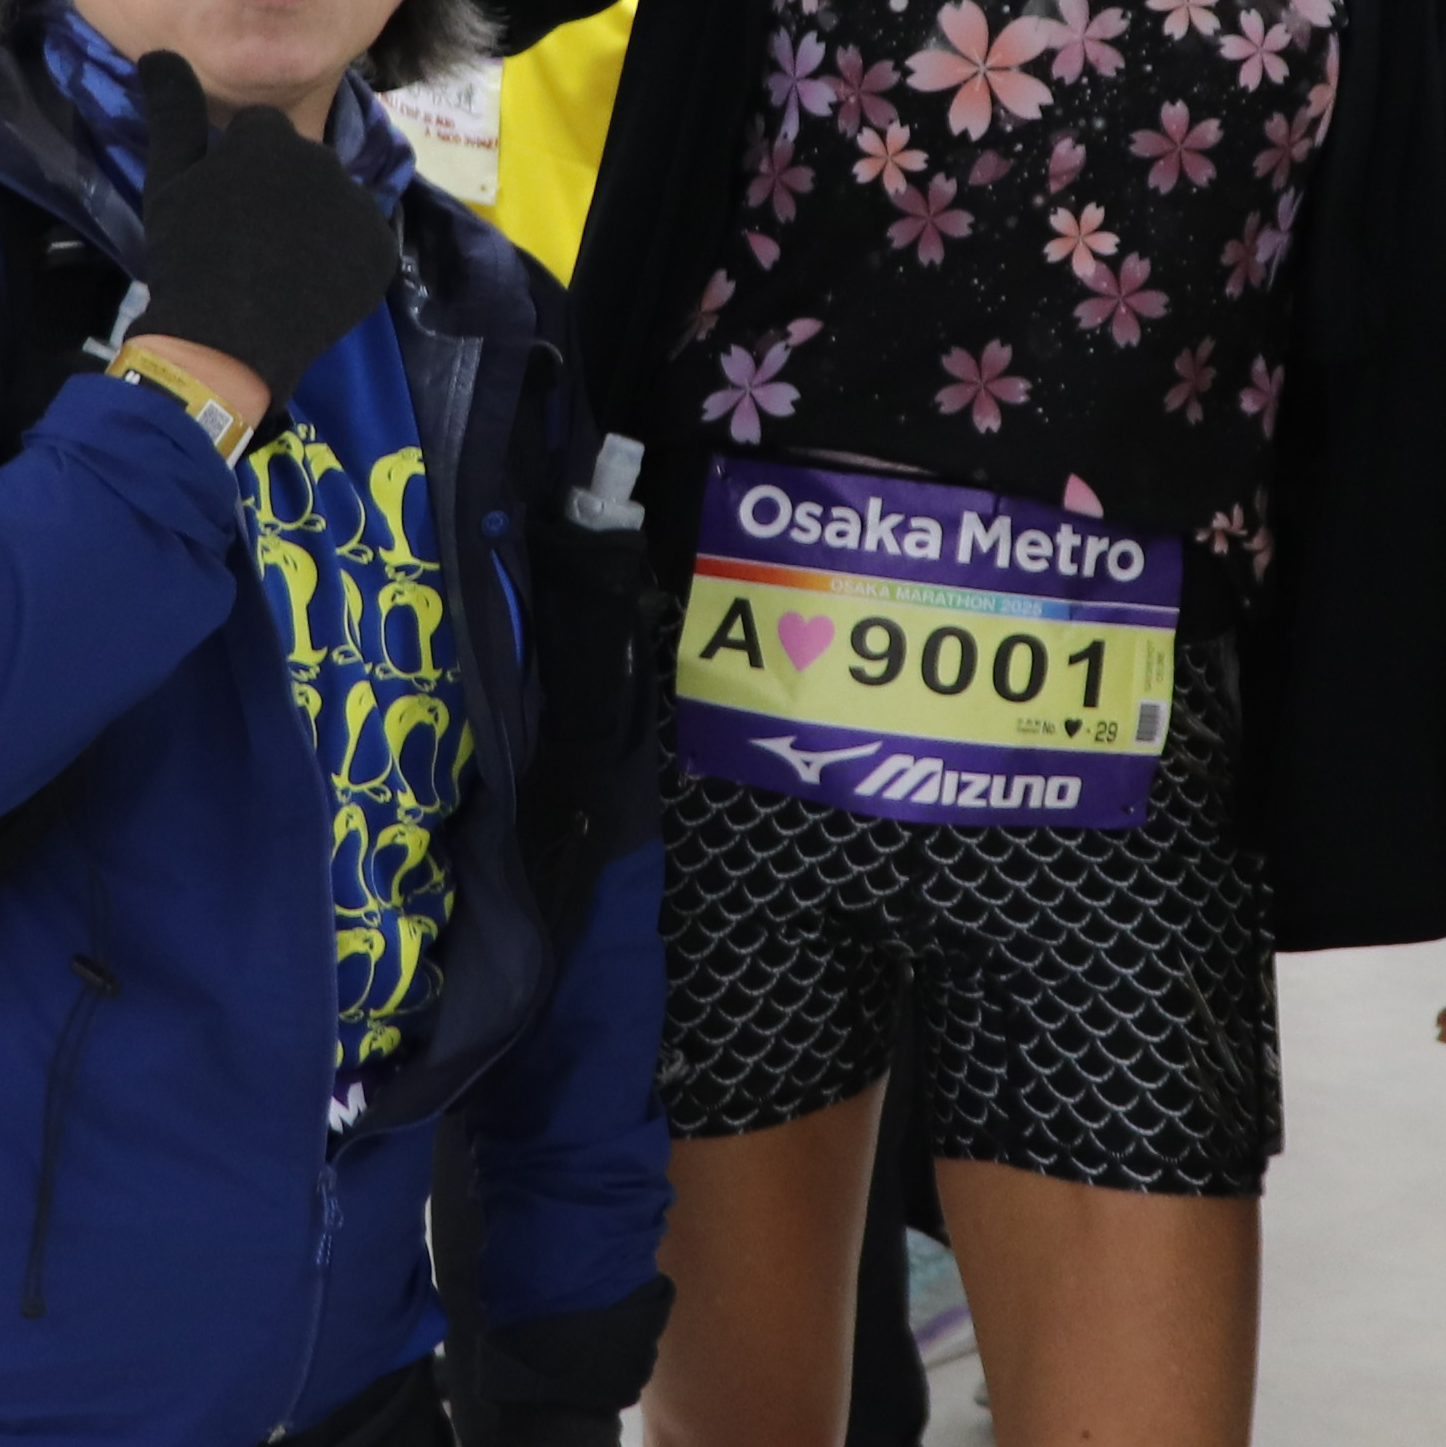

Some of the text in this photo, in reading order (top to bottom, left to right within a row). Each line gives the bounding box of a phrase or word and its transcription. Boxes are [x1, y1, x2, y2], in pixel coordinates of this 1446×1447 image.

[738, 484, 1145, 582] Osaka Metro
[829, 577, 1043, 617] OSAKA MARATHON 2025
[699, 597, 765, 669] A
[848, 616, 1106, 709] 9001
